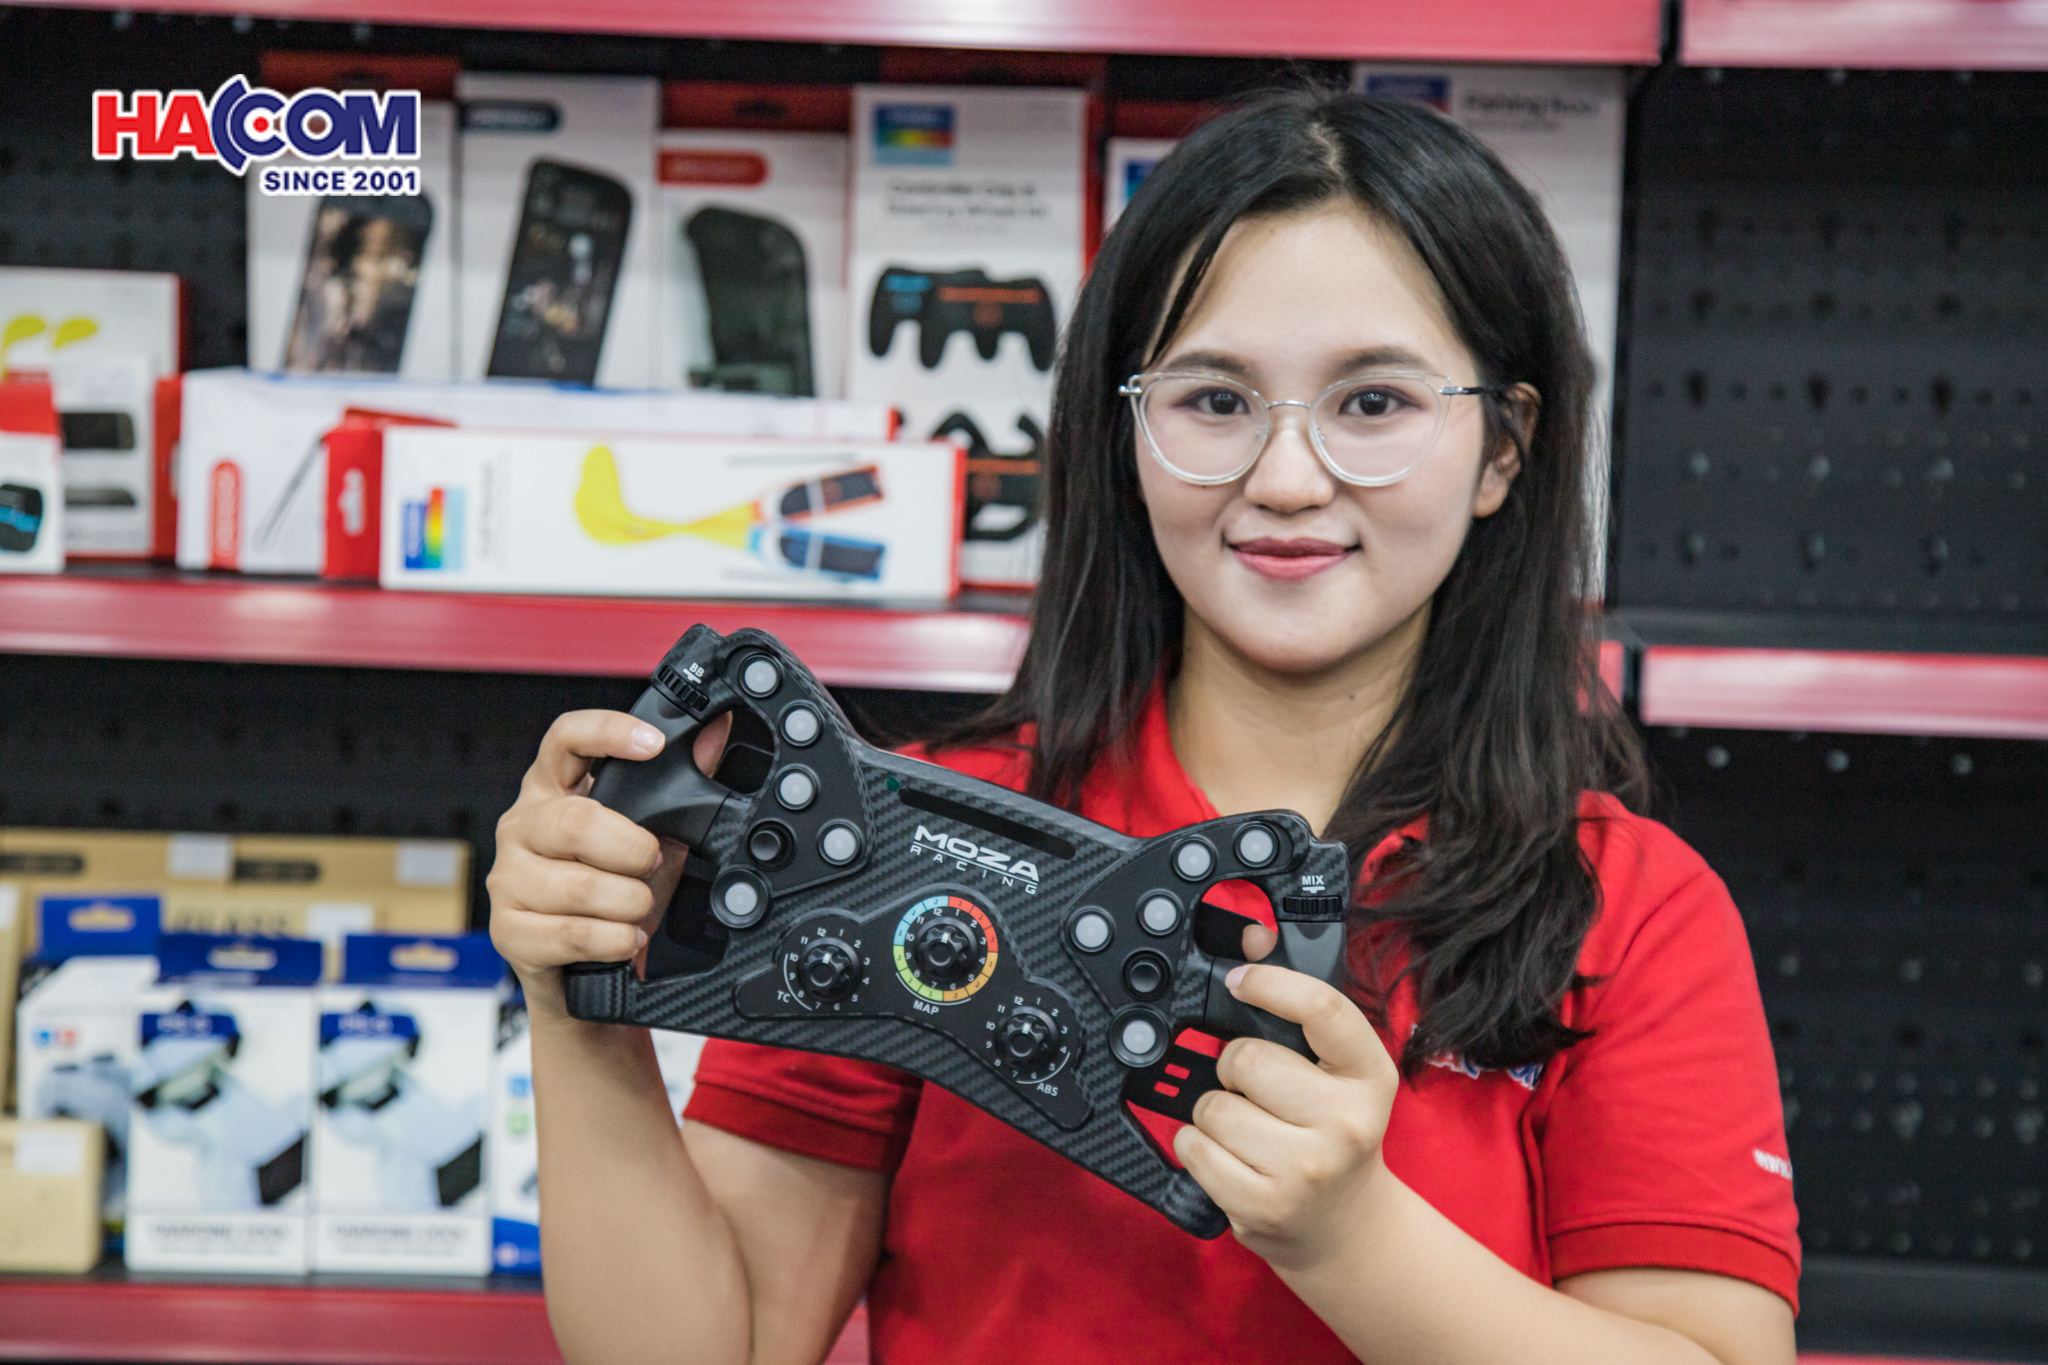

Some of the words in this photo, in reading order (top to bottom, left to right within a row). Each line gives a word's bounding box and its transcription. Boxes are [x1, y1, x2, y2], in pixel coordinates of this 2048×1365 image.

[689, 662, 704, 677] BB
[914, 825, 1039, 882] MOZA
[910, 844, 1037, 895] RACING
[1302, 875, 1324, 885] MIX
[933, 908, 942, 916] 12
[917, 916, 924, 924] 11
[970, 920, 977, 928] 2
[817, 927, 826, 937] 12
[839, 928, 844, 936] 1
[800, 936, 808, 945] 11
[906, 933, 914, 941] 10
[854, 940, 861, 948] 2
[790, 953, 798, 962] 10
[863, 957, 870, 965] 3
[789, 972, 795, 980] 9
[968, 974, 974, 982] 5
[777, 990, 790, 1003] TC
[798, 990, 804, 998] 8
[851, 994, 858, 1002] 5
[1014, 996, 1023, 1005] 12
[1037, 997, 1041, 1005] 1
[833, 1003, 840, 1011] 6
[913, 1000, 939, 1015] MAP
[997, 1004, 1005, 1013] 11
[1051, 1008, 1058, 1017] 2
[986, 1022, 995, 1031] 10
[1061, 1026, 1068, 1034] 3
[986, 1041, 992, 1049] 9
[994, 1059, 1001, 1067] 8
[1049, 1063, 1055, 1071] 5
[1012, 1070, 1018, 1078] 7
[1031, 1072, 1037, 1080] 6
[1036, 1082, 1058, 1097] ABS
